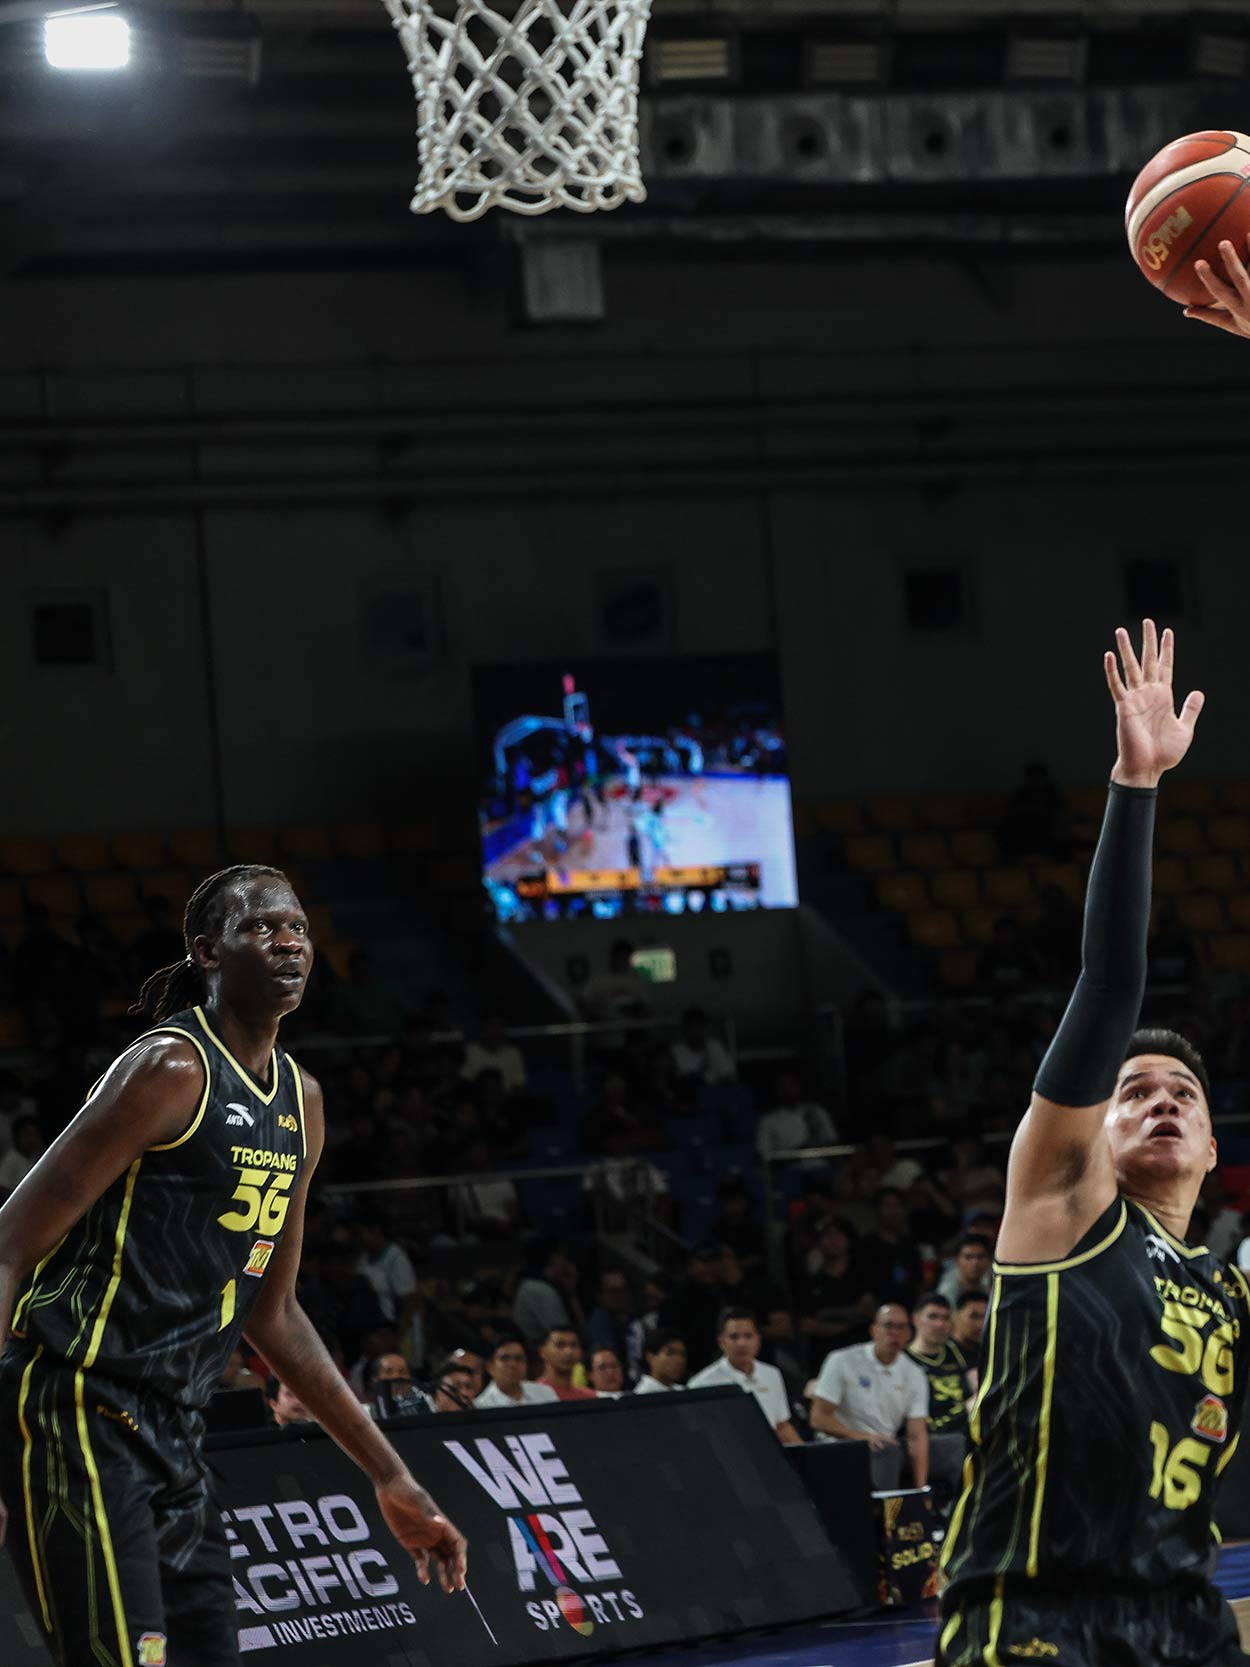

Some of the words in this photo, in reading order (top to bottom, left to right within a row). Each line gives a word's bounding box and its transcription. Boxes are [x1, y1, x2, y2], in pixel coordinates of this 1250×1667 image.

[230, 1145, 297, 1171] TROPANG
[217, 1167, 295, 1237] 5G
[217, 1278, 236, 1333] 1
[443, 1432, 583, 1510] WE
[1149, 1420, 1212, 1510] 16
[506, 1508, 624, 1592] ARE
[272, 1602, 417, 1645] INVESTMENTS
